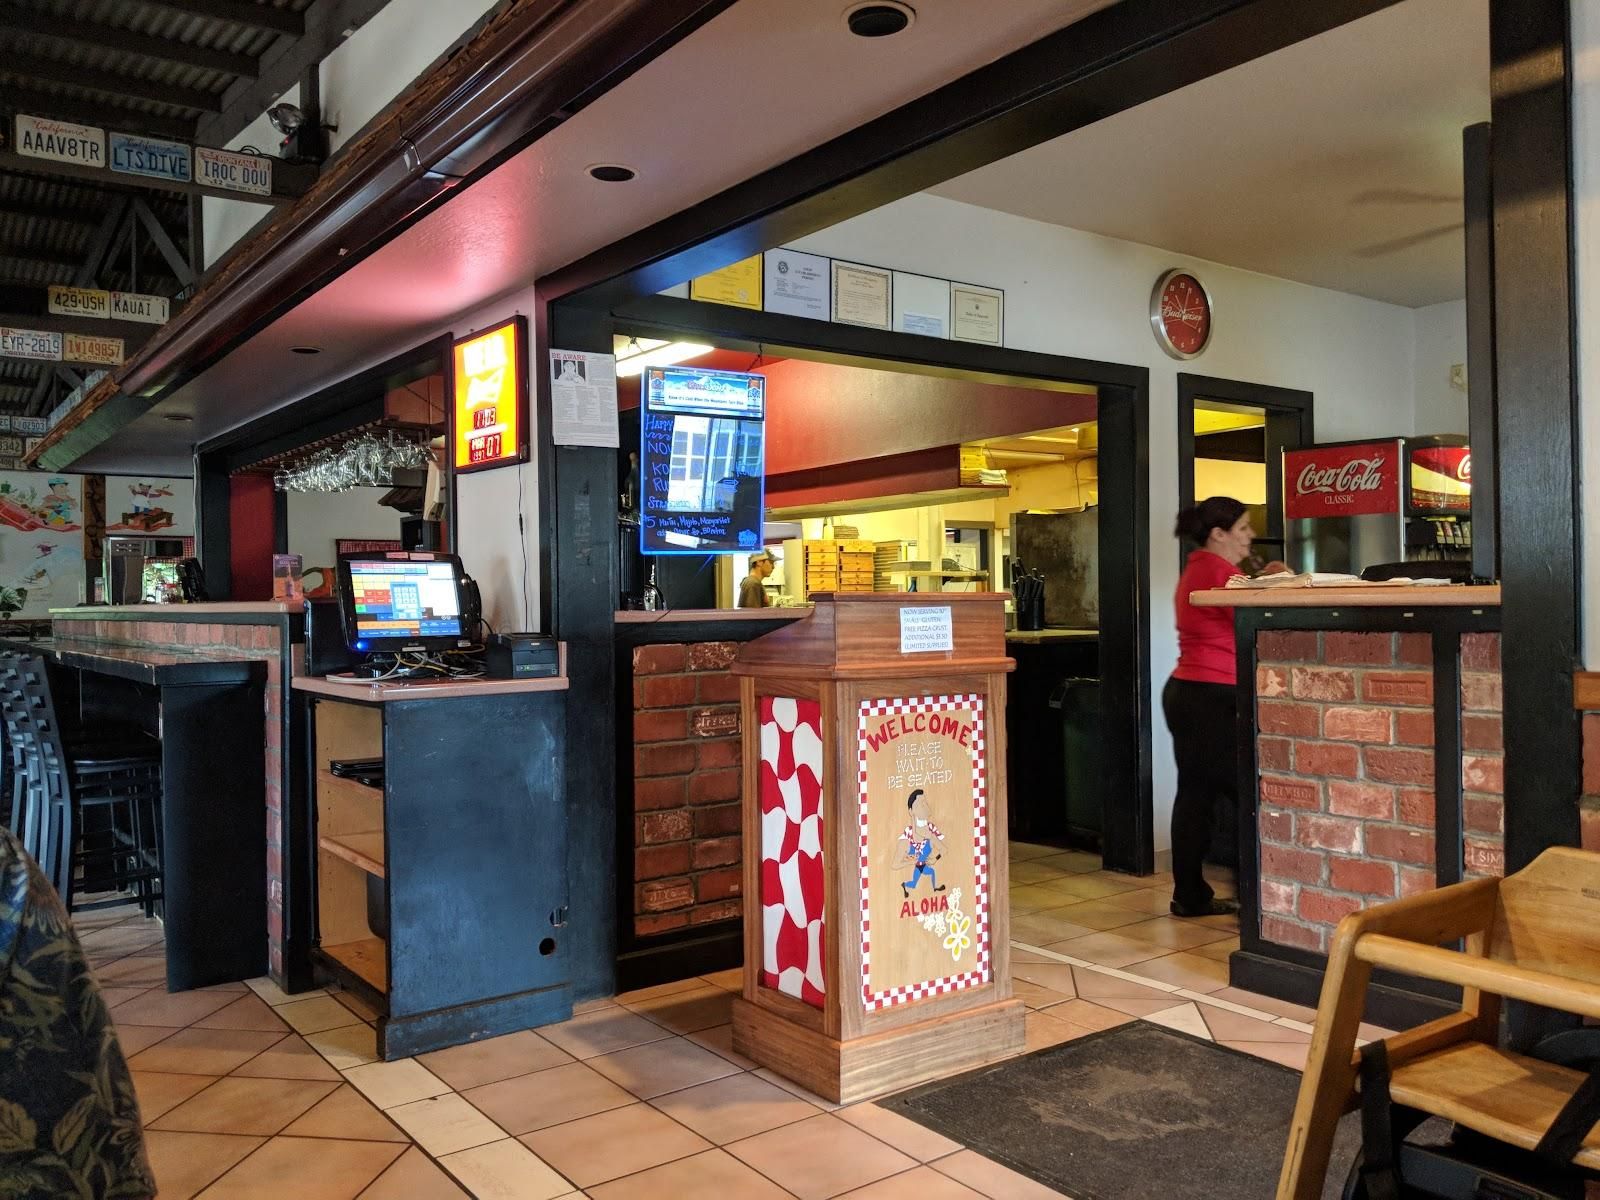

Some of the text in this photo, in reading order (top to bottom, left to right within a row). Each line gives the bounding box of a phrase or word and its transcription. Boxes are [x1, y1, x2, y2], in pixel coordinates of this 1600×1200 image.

[23, 129, 99, 161] AAAV8TR
[204, 160, 237, 182] IROC
[217, 155, 256, 169] MONTANA
[114, 299, 151, 317] KAUAI
[1163, 305, 1202, 321] Budweiser
[2, 336, 60, 354] EYR-2819
[552, 352, 561, 360] BE
[1296, 457, 1385, 495] Coca-Cola
[1324, 493, 1354, 505] CLASSIC
[866, 713, 973, 753] WELCOME
[896, 741, 941, 756] PLEASE
[895, 756, 944, 773] WAIT TO
[888, 769, 953, 790] BE SEATED
[900, 895, 949, 918] ALOHA
